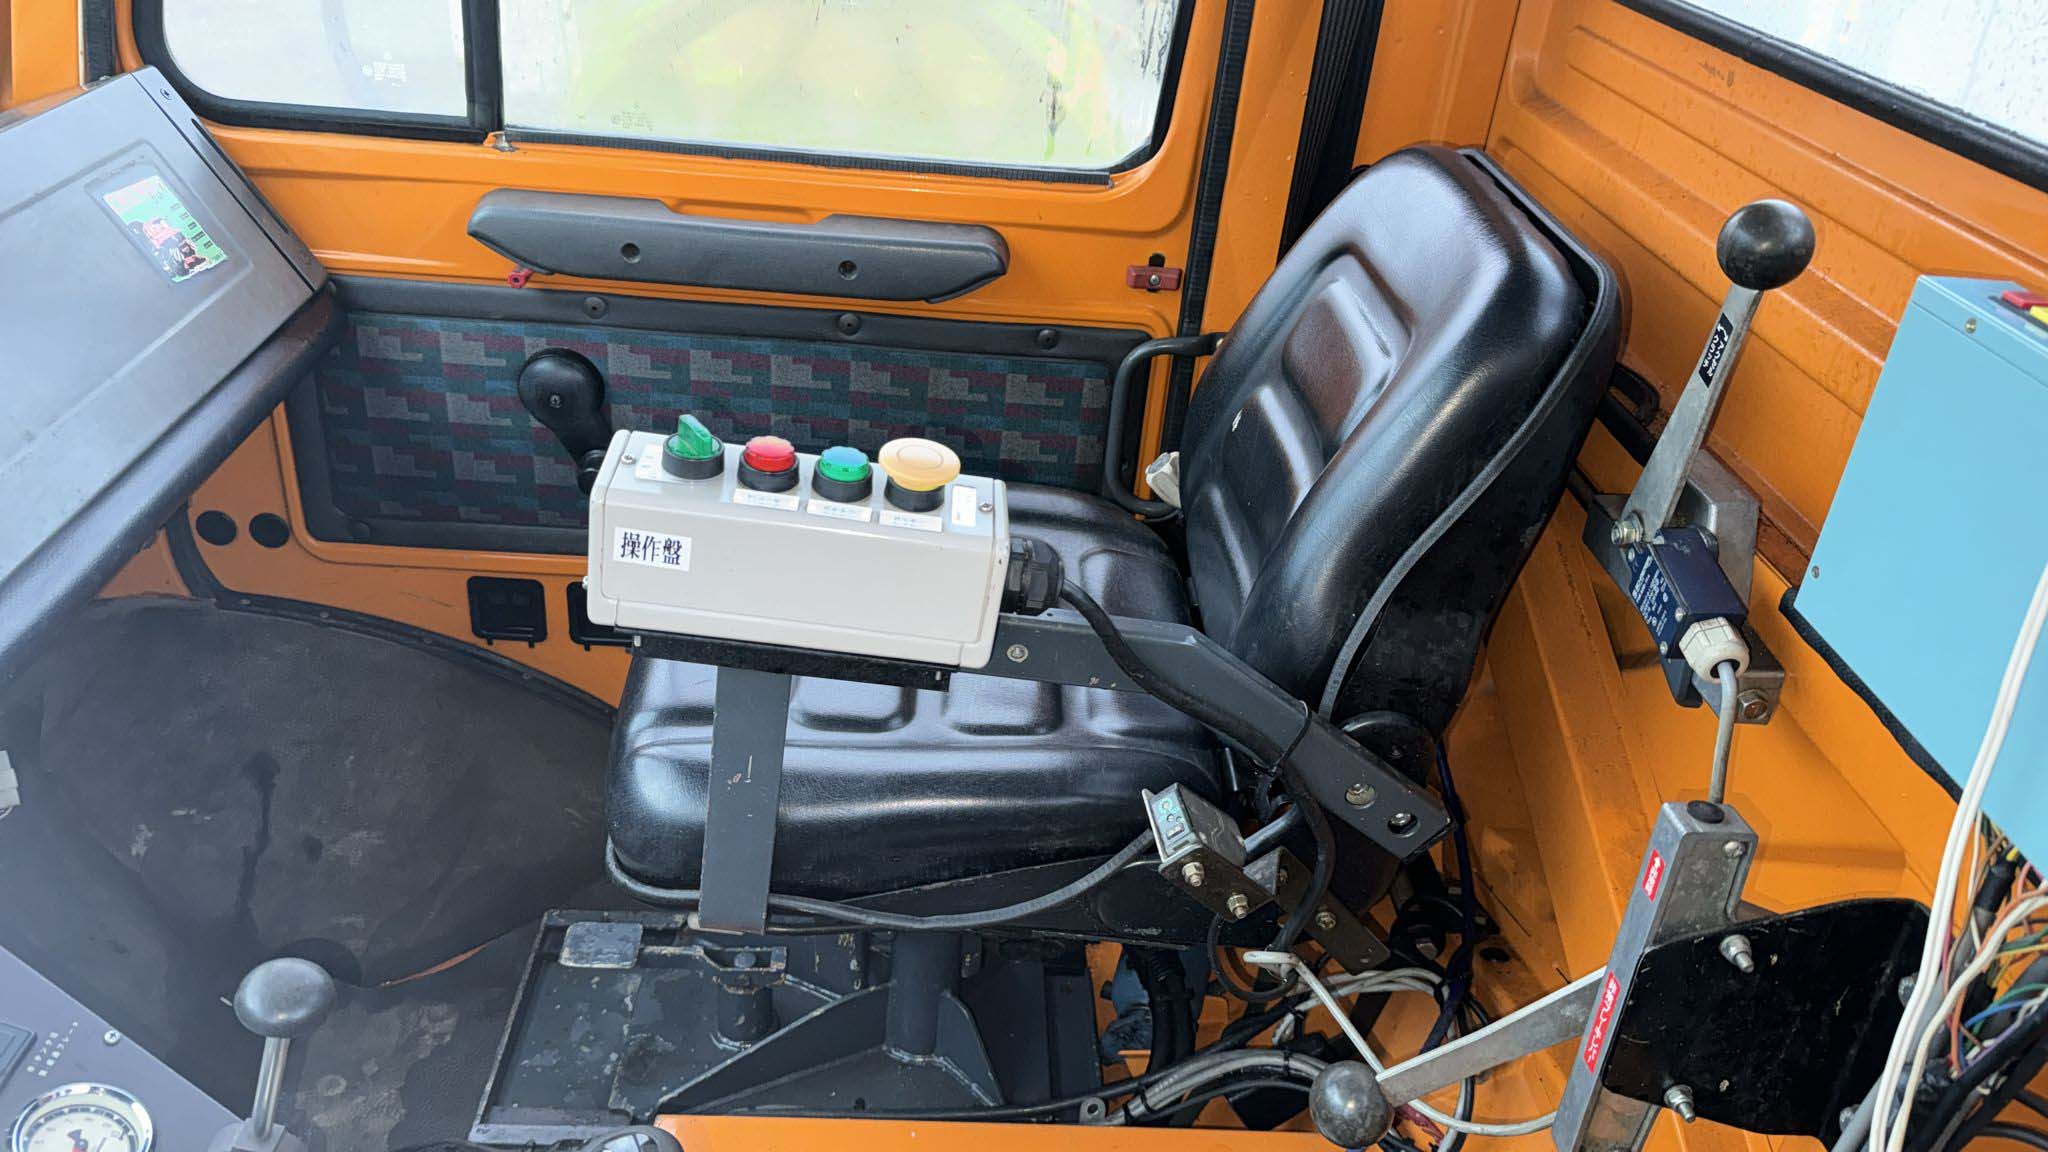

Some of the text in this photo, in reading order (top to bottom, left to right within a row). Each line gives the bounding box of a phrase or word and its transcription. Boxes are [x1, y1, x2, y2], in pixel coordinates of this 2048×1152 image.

[1702, 334, 1720, 368] クラッチ
[1706, 340, 1725, 377] アクセル
[620, 531, 683, 566] 操作盤
